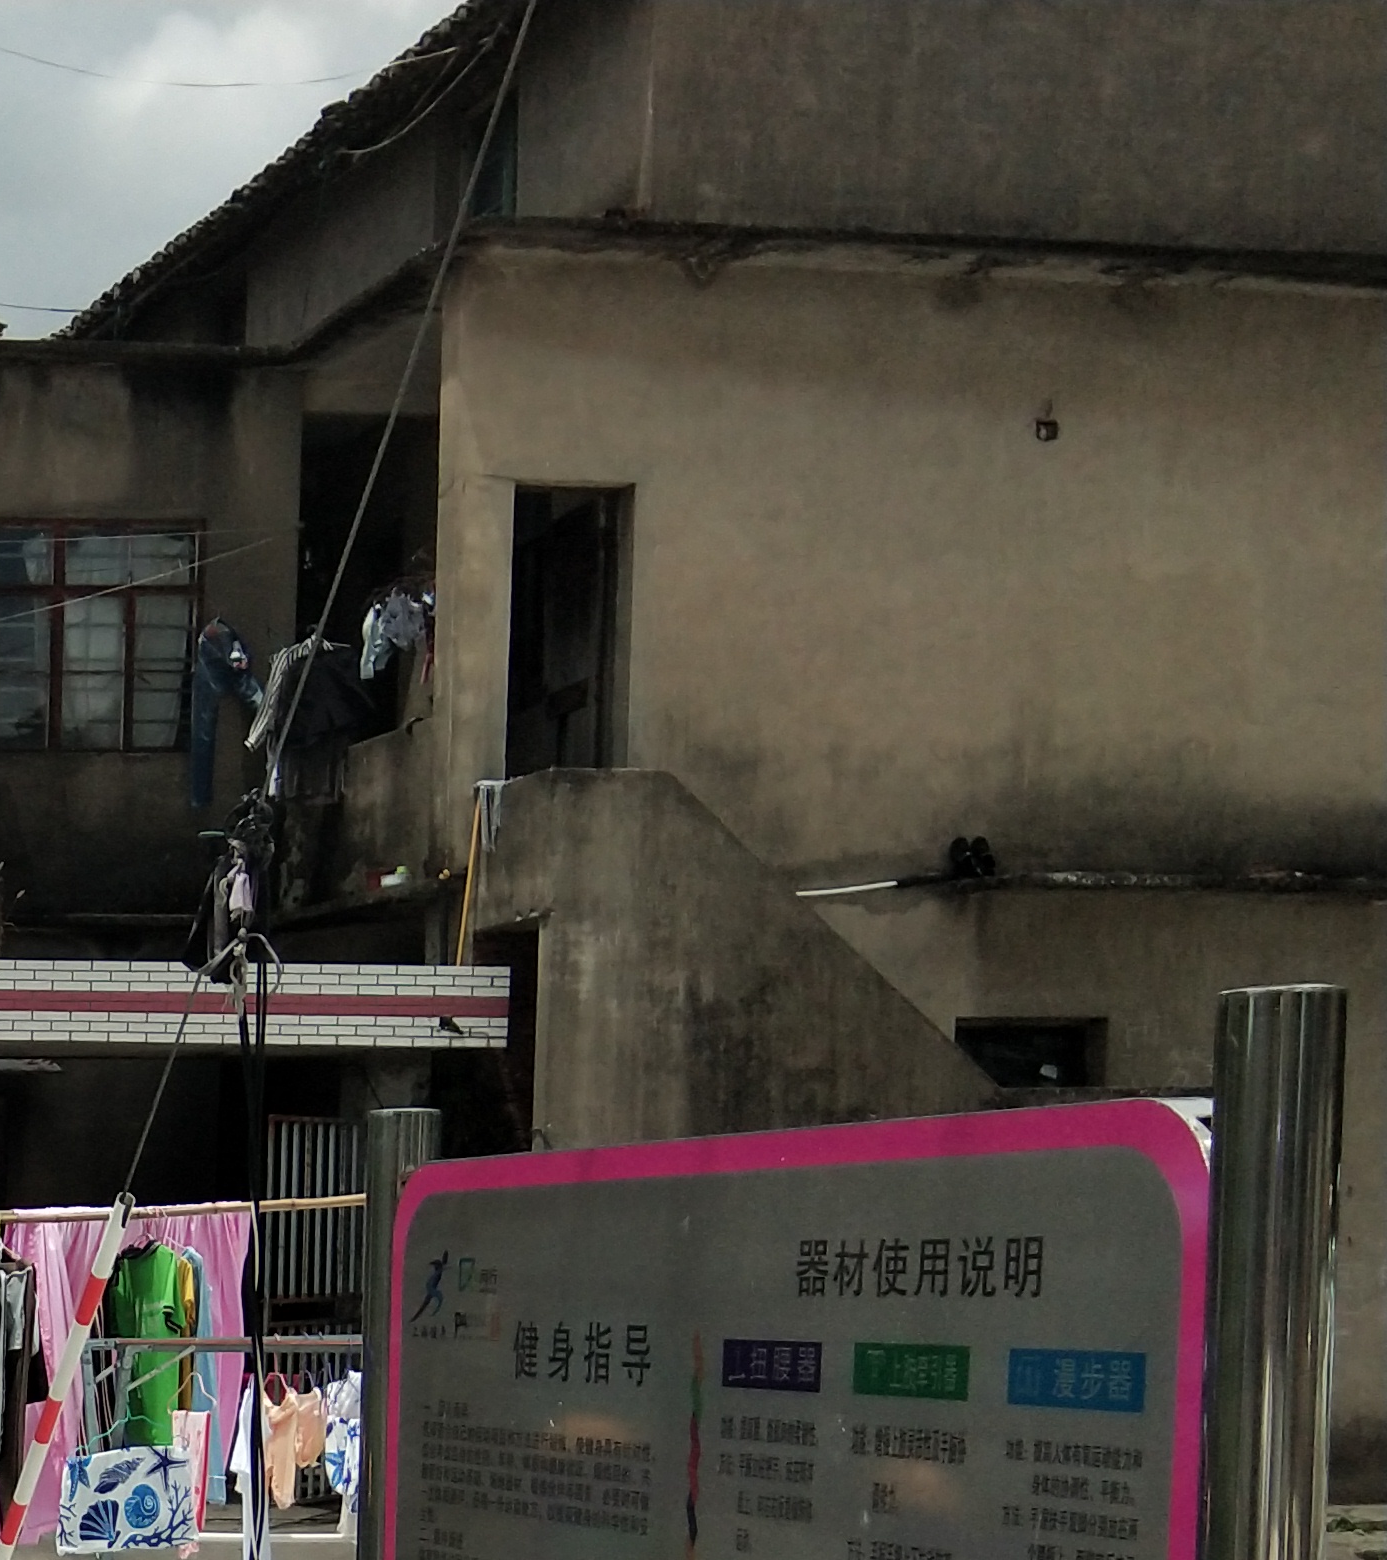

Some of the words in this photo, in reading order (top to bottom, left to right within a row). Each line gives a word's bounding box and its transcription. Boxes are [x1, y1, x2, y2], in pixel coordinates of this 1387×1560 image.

[794, 1234, 1046, 1299] 器材使用说明
[511, 1320, 654, 1388] 健身指导
[749, 1345, 817, 1385] 扭腰器
[1052, 1355, 1135, 1403] 漫步器
